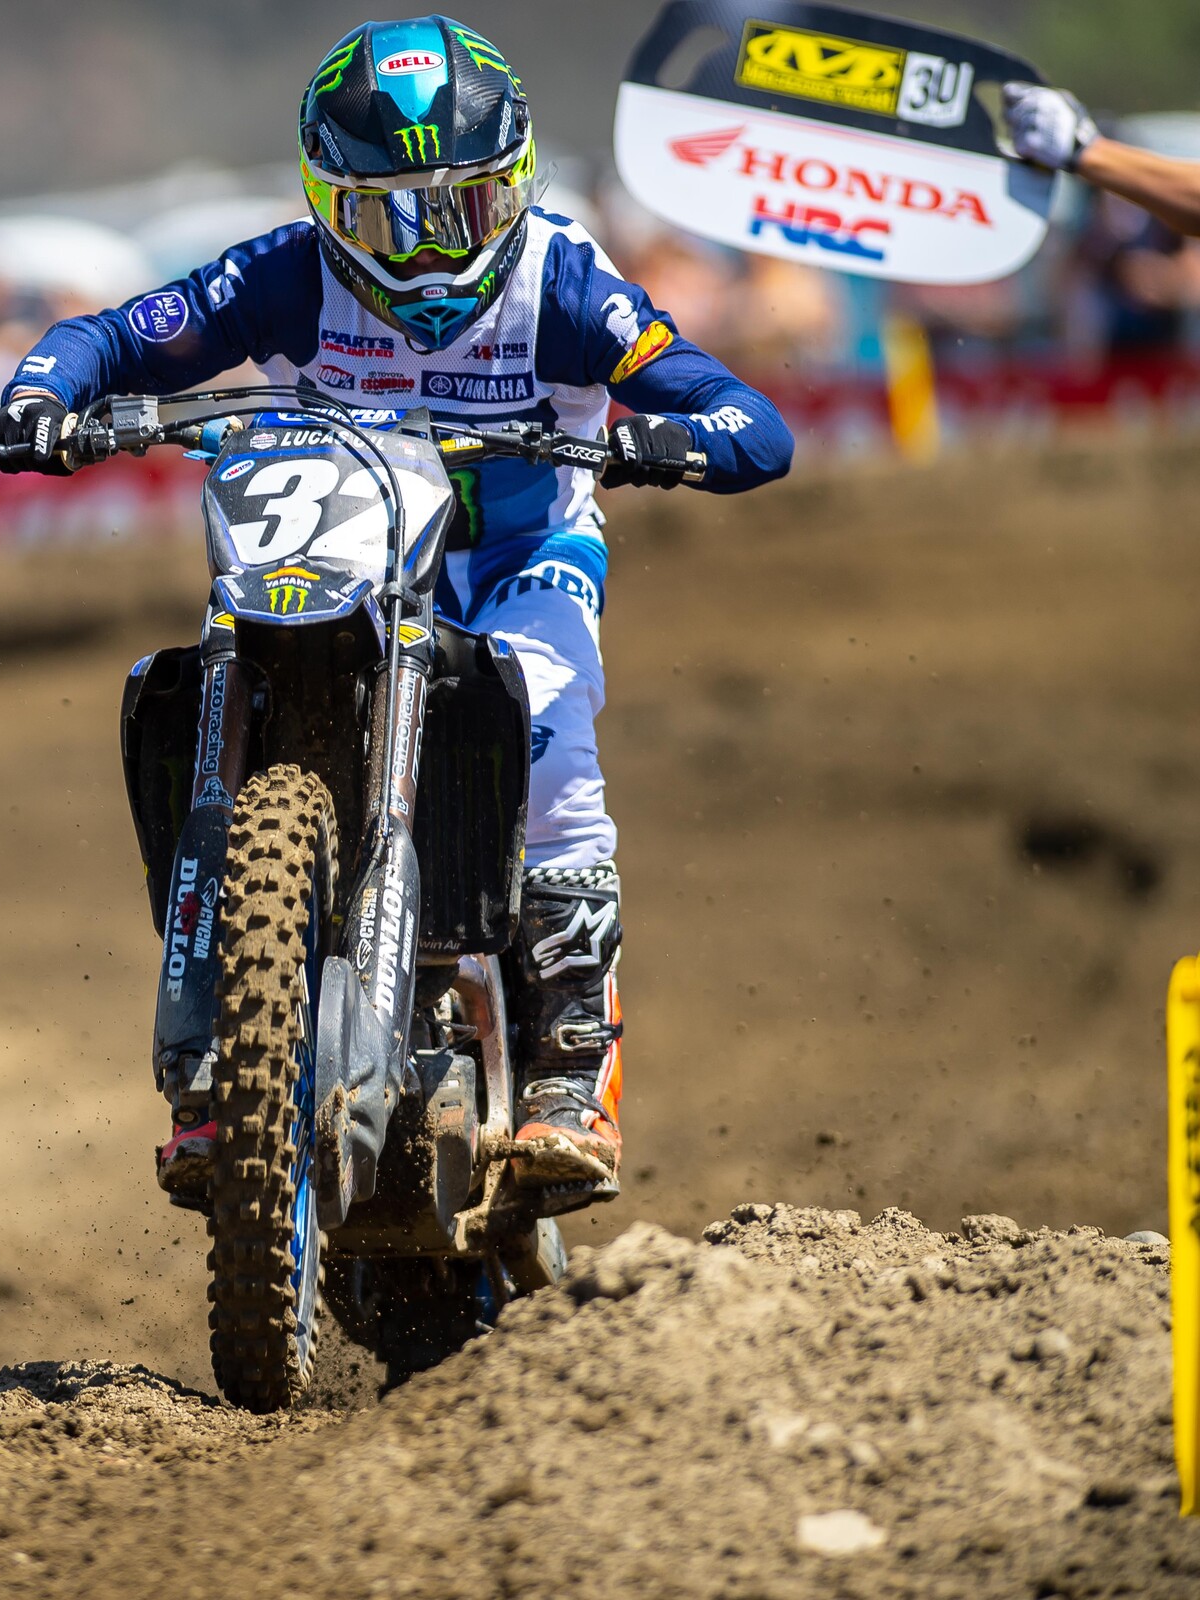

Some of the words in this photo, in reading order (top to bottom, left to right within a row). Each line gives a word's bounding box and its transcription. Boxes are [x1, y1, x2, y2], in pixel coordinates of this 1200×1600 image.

[387, 56, 435, 70] BELL
[738, 147, 995, 228] HONDA
[749, 195, 892, 262] HRC
[425, 288, 444, 296] BELL
[150, 309, 169, 333] CRU
[320, 329, 395, 351] PARTS
[321, 341, 395, 359] UNLIMITED
[502, 342, 528, 354] PRO
[453, 376, 528, 400] YAMAHA
[34, 416, 51, 455] THOR
[280, 430, 350, 447] LUCAS
[552, 443, 606, 463] ARC
[229, 458, 452, 565] 32
[266, 577, 312, 588] YAMAHA
[193, 907, 215, 960] CYCRA
[417, 939, 443, 949] win
[443, 939, 462, 950] Air
